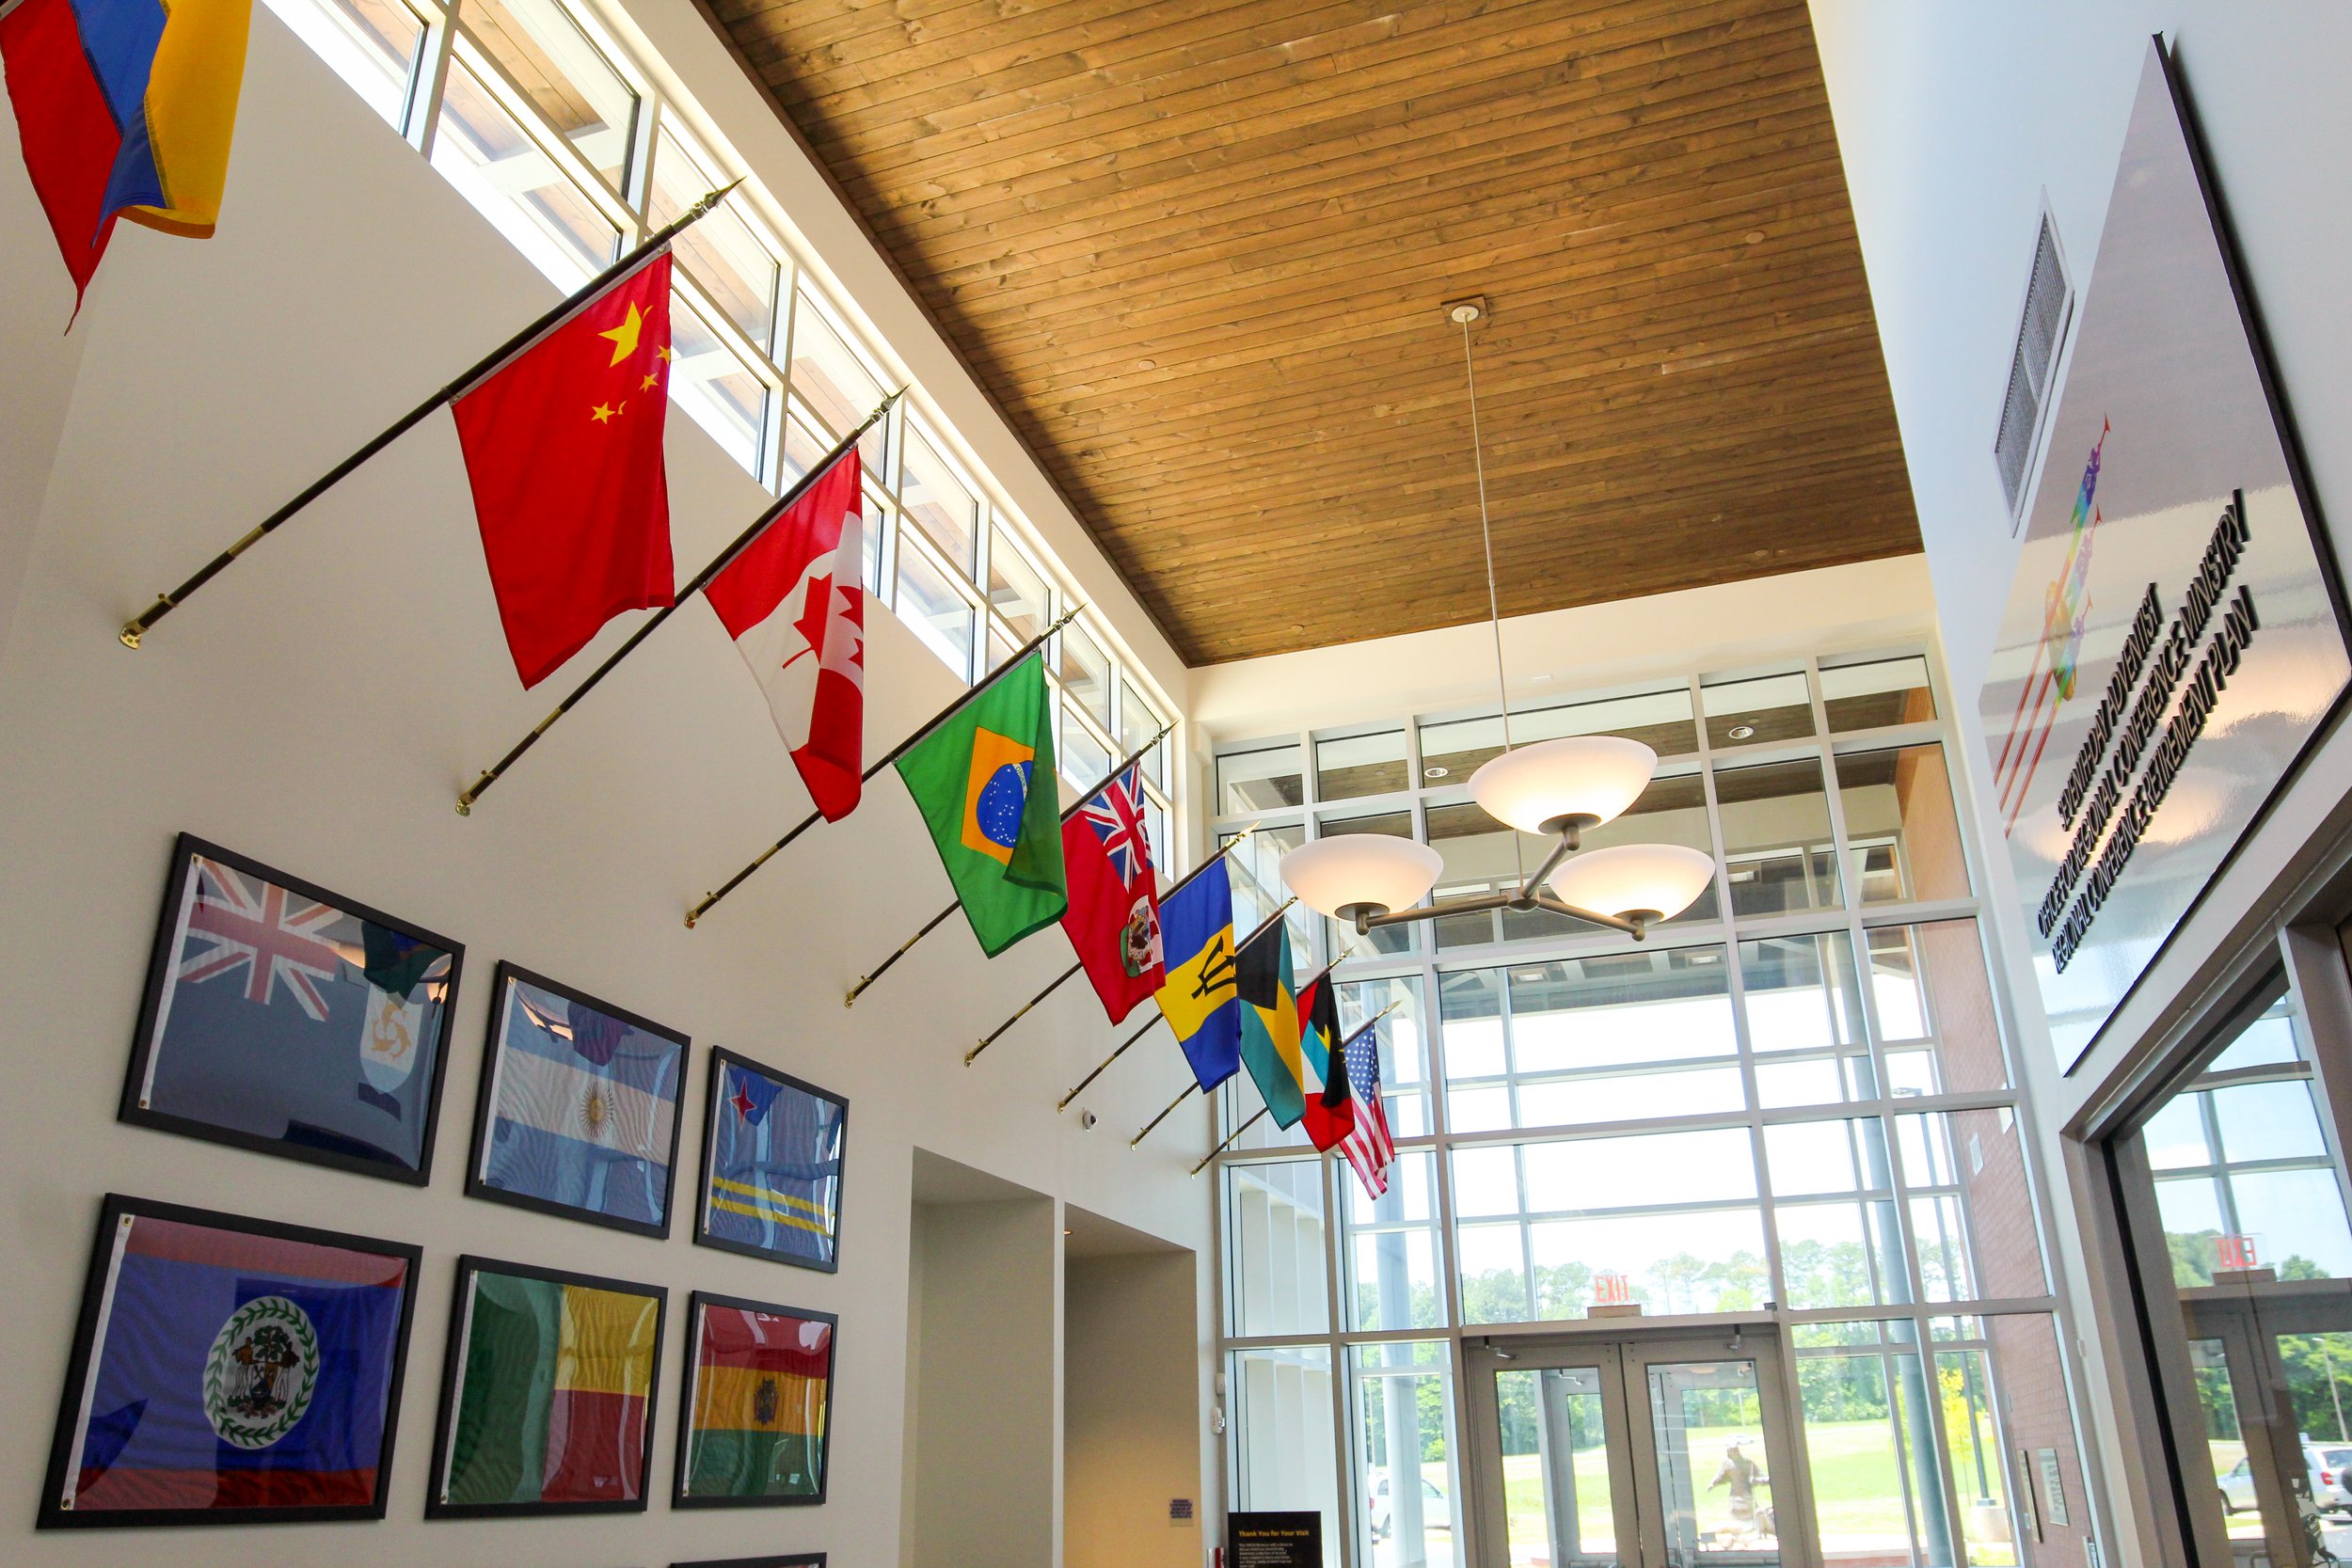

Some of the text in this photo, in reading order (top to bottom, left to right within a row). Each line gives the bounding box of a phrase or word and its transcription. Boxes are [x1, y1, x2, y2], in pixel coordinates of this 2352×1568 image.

[2038, 488, 2250, 939] OFFICE FOR REGIONAL CONFERENCE MINISTRY
[2052, 585, 2261, 974] REGIONAL CONFERENCE RETIREMENT PLAN
[2058, 582, 2165, 832] SEVENTH-DAY ADVENTIST
[1596, 1275, 1629, 1302] EXIT
